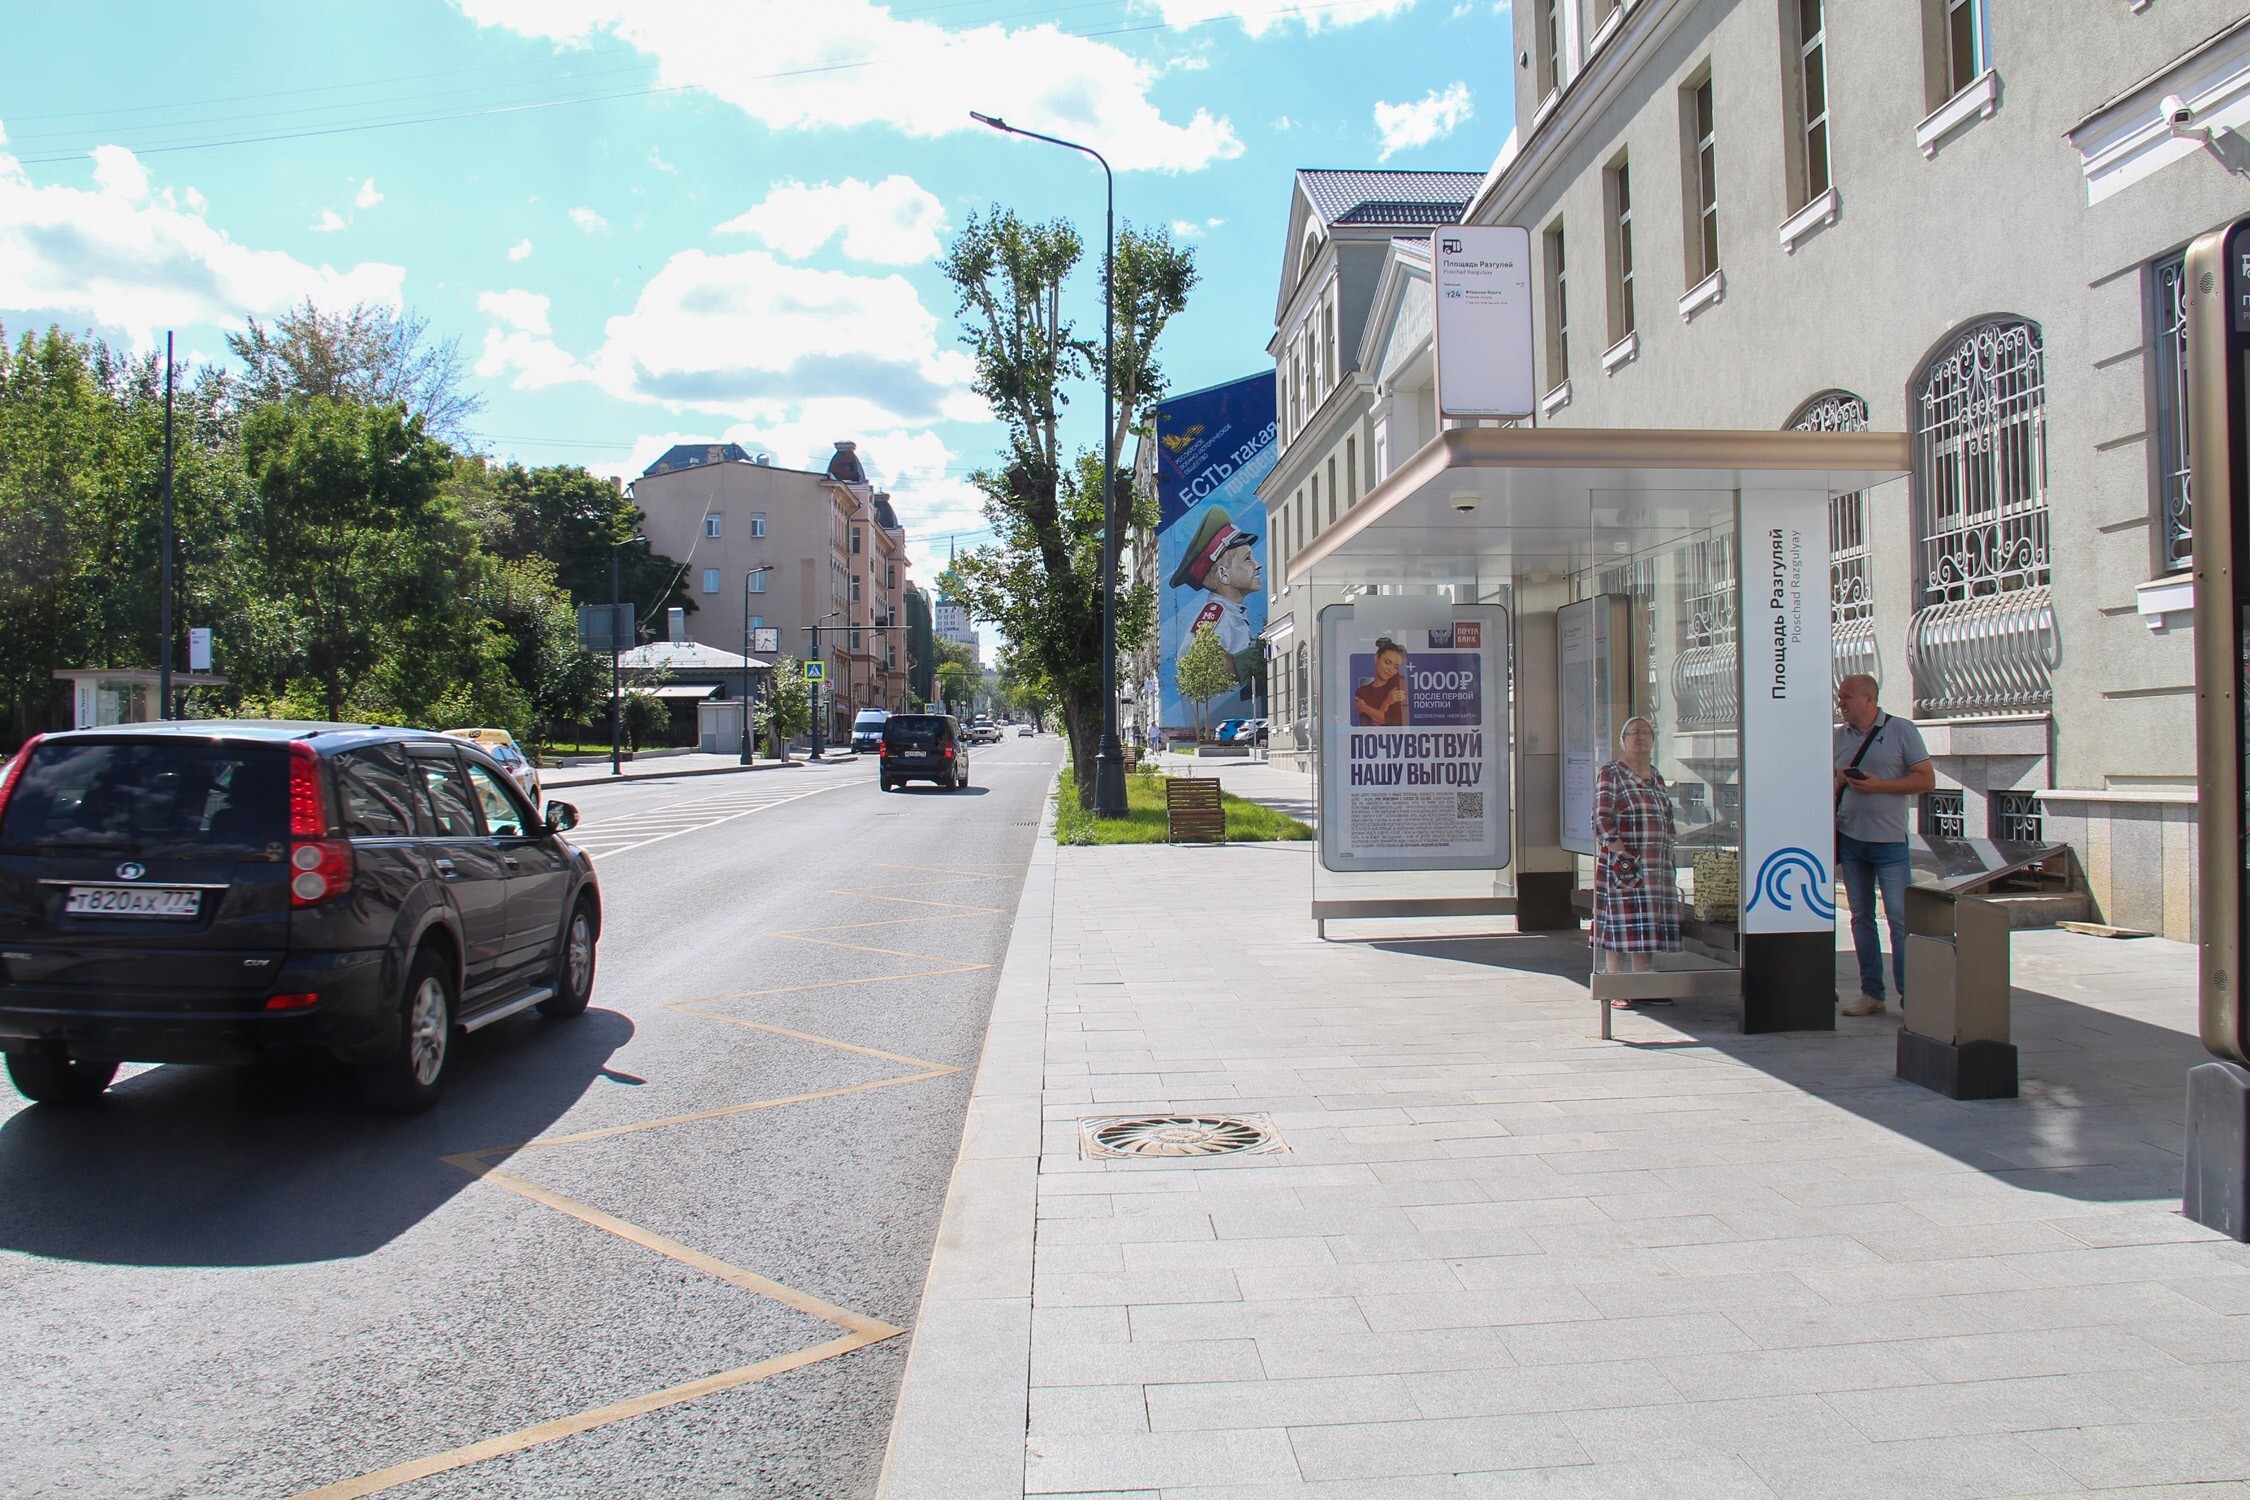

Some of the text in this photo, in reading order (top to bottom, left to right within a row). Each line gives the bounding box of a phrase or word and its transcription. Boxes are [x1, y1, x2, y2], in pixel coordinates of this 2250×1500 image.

[1443, 260, 1514, 269] Площадь Разгуляй
[1175, 438, 1205, 465] РОССИЙСКОЕ
[1179, 422, 1233, 471] ВОЕННО-ИСТОРИЧЕСКОЕ
[1178, 420, 1278, 509] ЕСТЬ такая
[1183, 453, 1209, 476] ОБЩЕСТВО
[1789, 530, 1803, 643] Ploschad Razgulyay
[1768, 528, 1787, 700] Площадь Разгуляй
[1414, 690, 1474, 700] ПОСЛЕ ПЕРВОЙ
[1414, 700, 1451, 709] ПОКУПКИ
[1350, 729, 1482, 759] ПОЧУВСТВУЙ
[1350, 762, 1482, 788] НАШУ ВЫГОДУ
